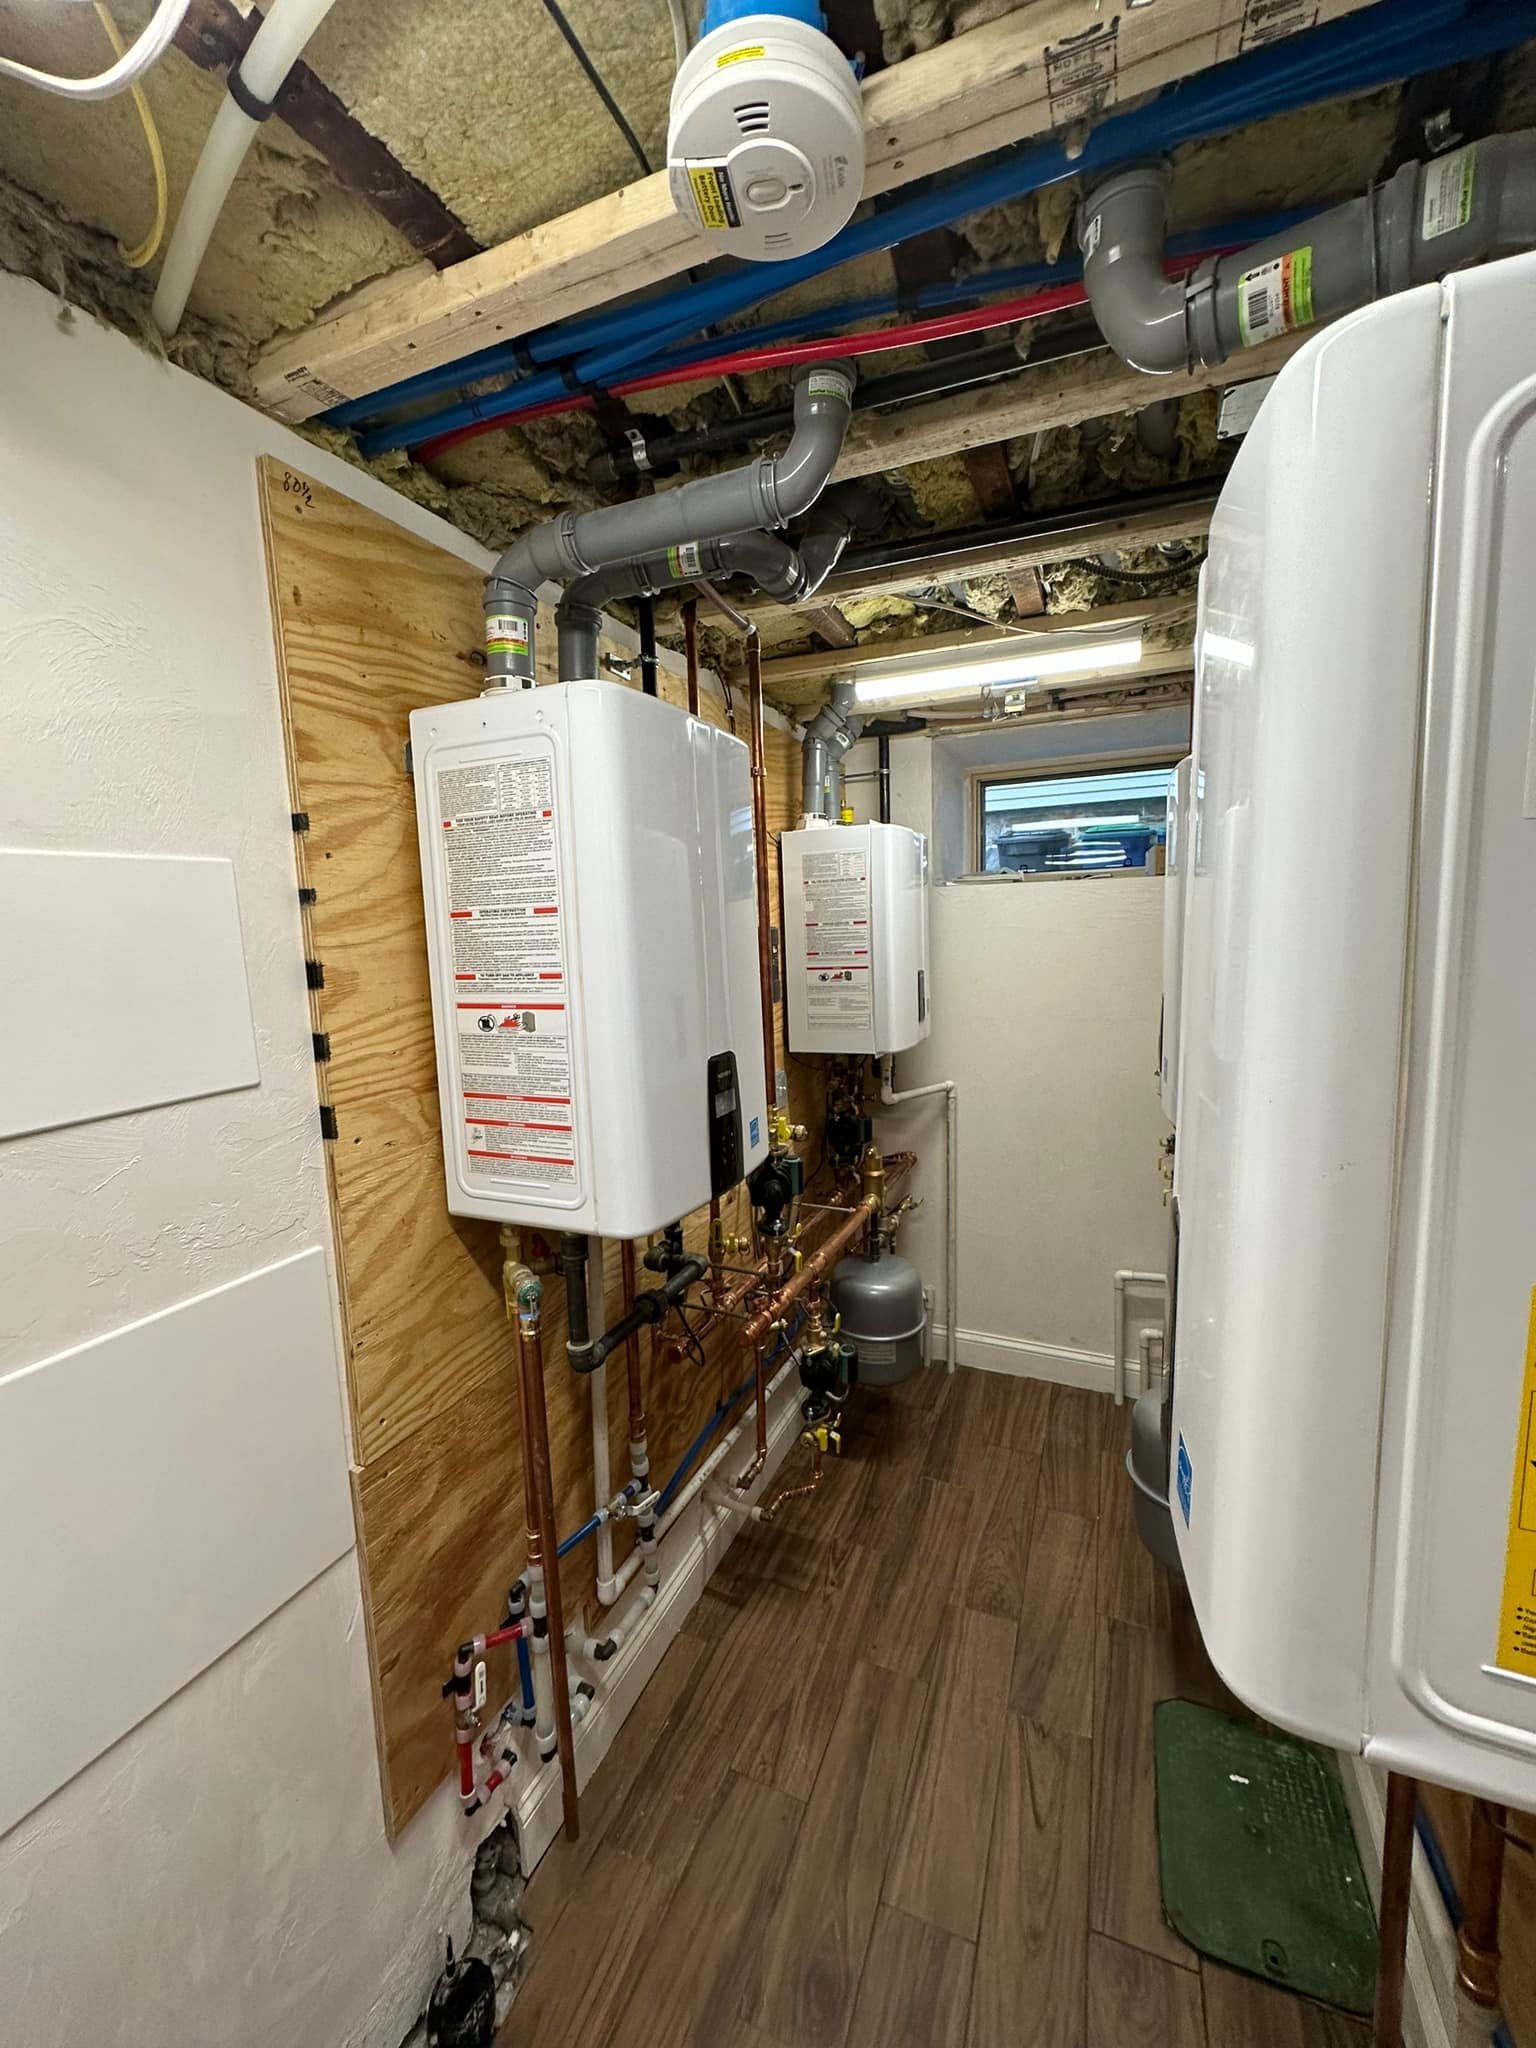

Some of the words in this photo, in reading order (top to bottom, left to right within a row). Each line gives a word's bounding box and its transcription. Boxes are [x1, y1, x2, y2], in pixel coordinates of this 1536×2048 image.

[699, 174, 710, 203] Battery
[707, 204, 717, 222] Door
[706, 171, 718, 194] Front
[713, 195, 726, 224] Loading
